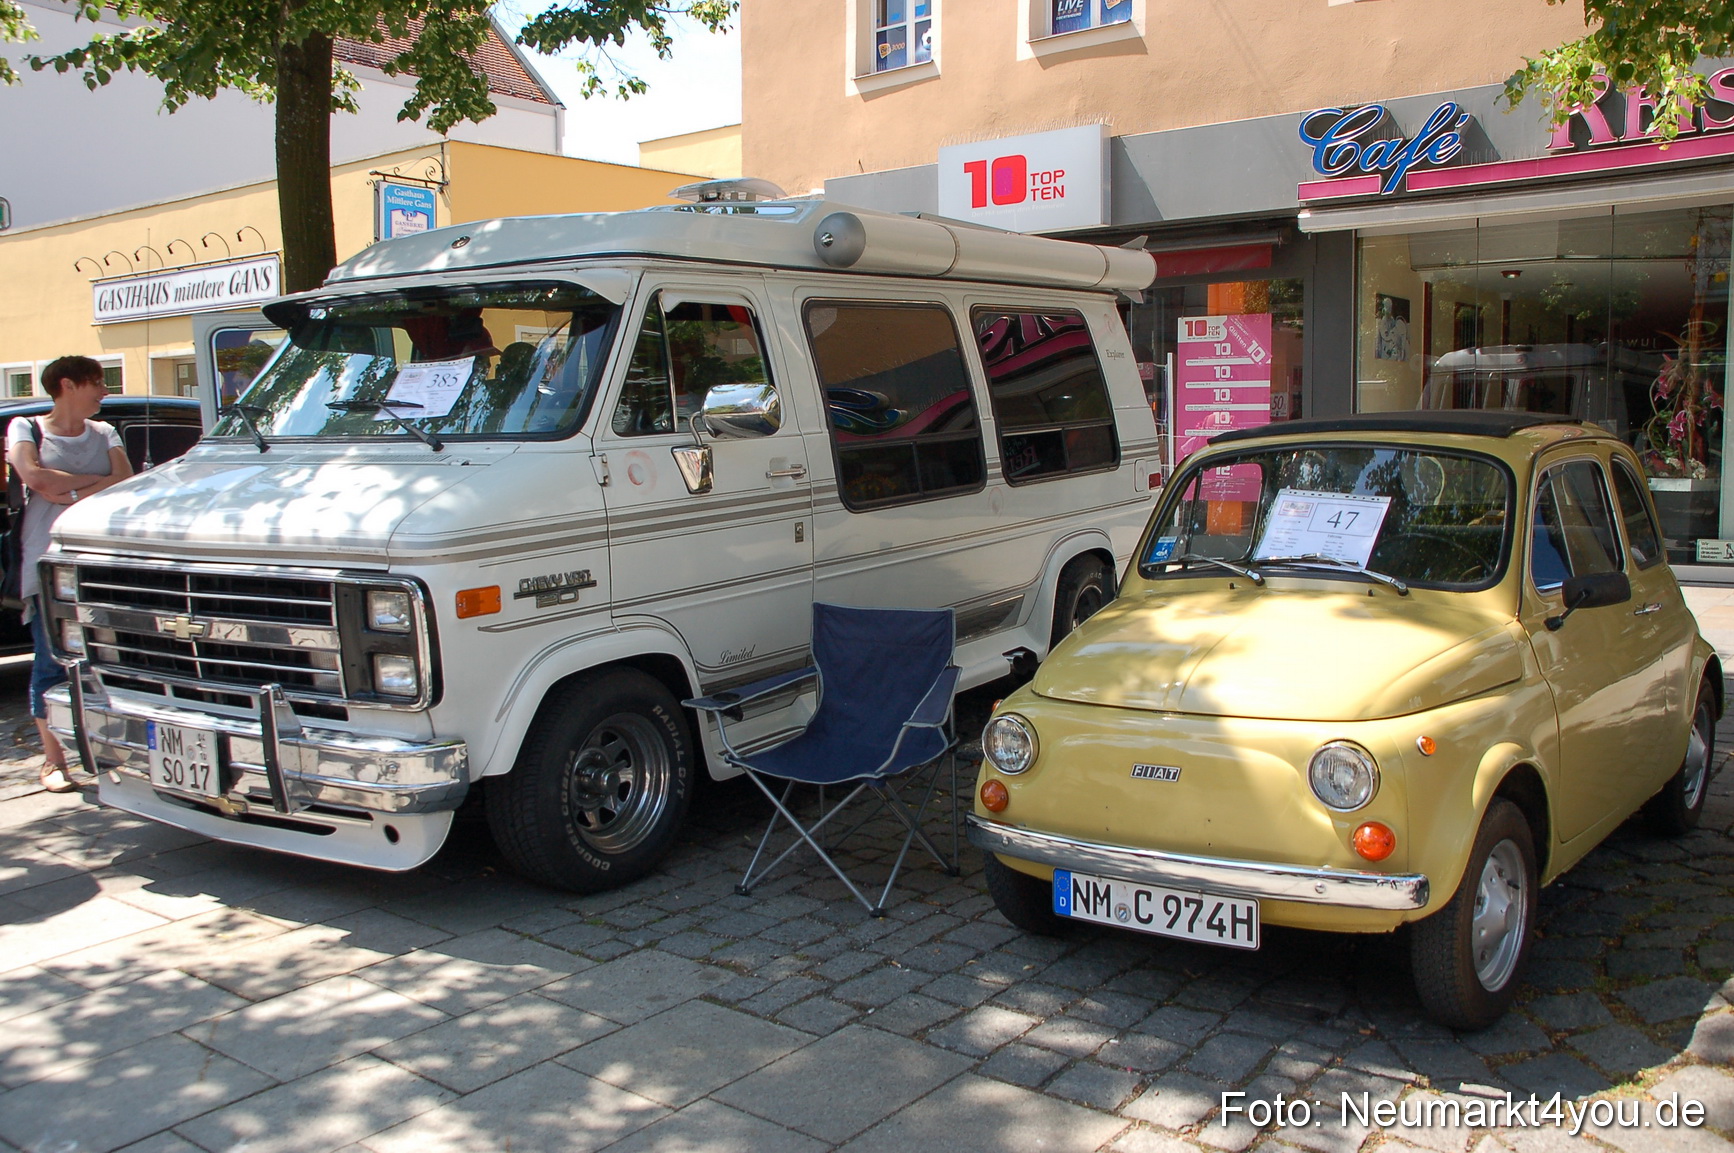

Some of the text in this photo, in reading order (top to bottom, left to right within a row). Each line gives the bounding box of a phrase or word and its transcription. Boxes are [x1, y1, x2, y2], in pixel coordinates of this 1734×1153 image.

[1057, 0, 1084, 12] LIVE
[1298, 100, 1471, 195] Café
[964, 154, 1065, 209] 10 TOP
[387, 195, 432, 209] Mittlere Gans
[394, 188, 425, 199] Gasthaus
[1030, 185, 1065, 201] TEN
[98, 265, 272, 312] GASTHAUS mittlere GANS
[1185, 319, 1208, 337] 10
[426, 372, 461, 389] 385
[1327, 510, 1360, 530] 47
[519, 572, 563, 592] CHEVY
[718, 644, 756, 665] Limited
[161, 727, 183, 756] NM
[652, 704, 686, 762] RADIAL
[163, 757, 210, 791] SO 17
[1132, 764, 1179, 781] FIAT
[565, 822, 611, 871] COOPER
[1059, 877, 1254, 942] D NM C 974H
